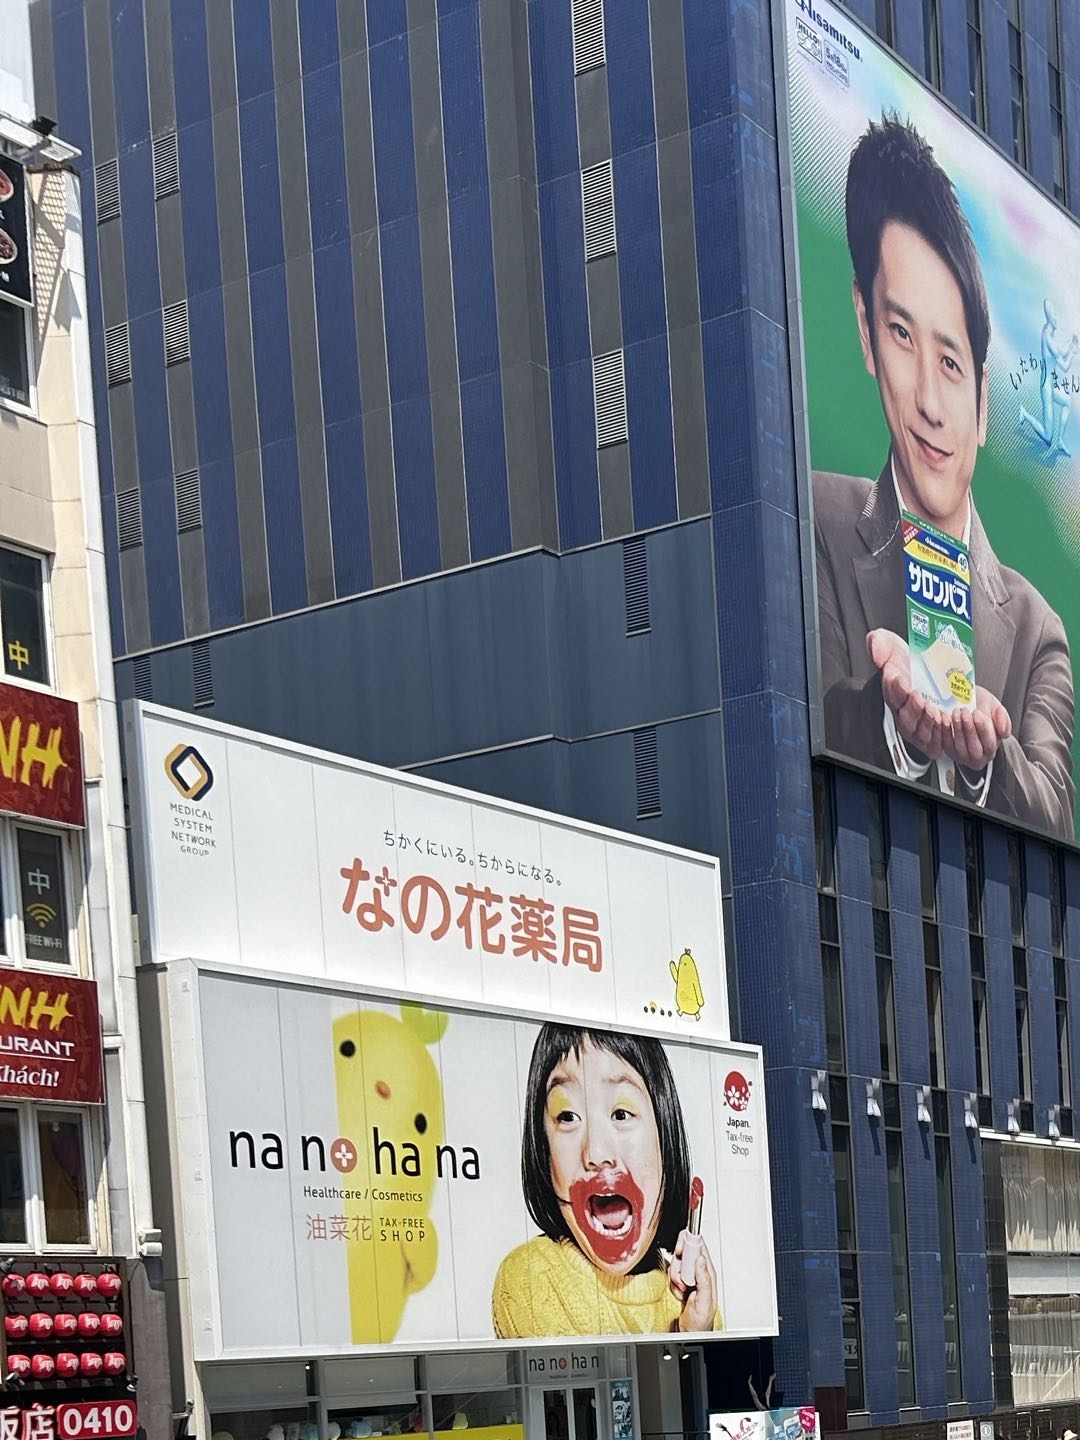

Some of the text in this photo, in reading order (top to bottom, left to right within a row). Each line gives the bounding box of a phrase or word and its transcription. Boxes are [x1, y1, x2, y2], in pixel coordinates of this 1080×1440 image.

[908, 561, 969, 619] サロンパス
[8, 640, 29, 671] 中
[170, 803, 214, 820] MEDICAL
[171, 831, 216, 848] NETWORK
[174, 818, 213, 834] SYSTEM
[180, 845, 210, 857] GROUP
[384, 830, 562, 886] ちかくにいる。ちからになる。
[28, 868, 50, 895] 中
[340, 857, 603, 973] なの花薬局
[731, 1144, 750, 1158] Shop
[303, 1186, 362, 1200] Healthcare
[371, 1188, 423, 1202] Cosmetics
[305, 1213, 373, 1242] 油菜花
[62, 1404, 134, 1437] 0410
